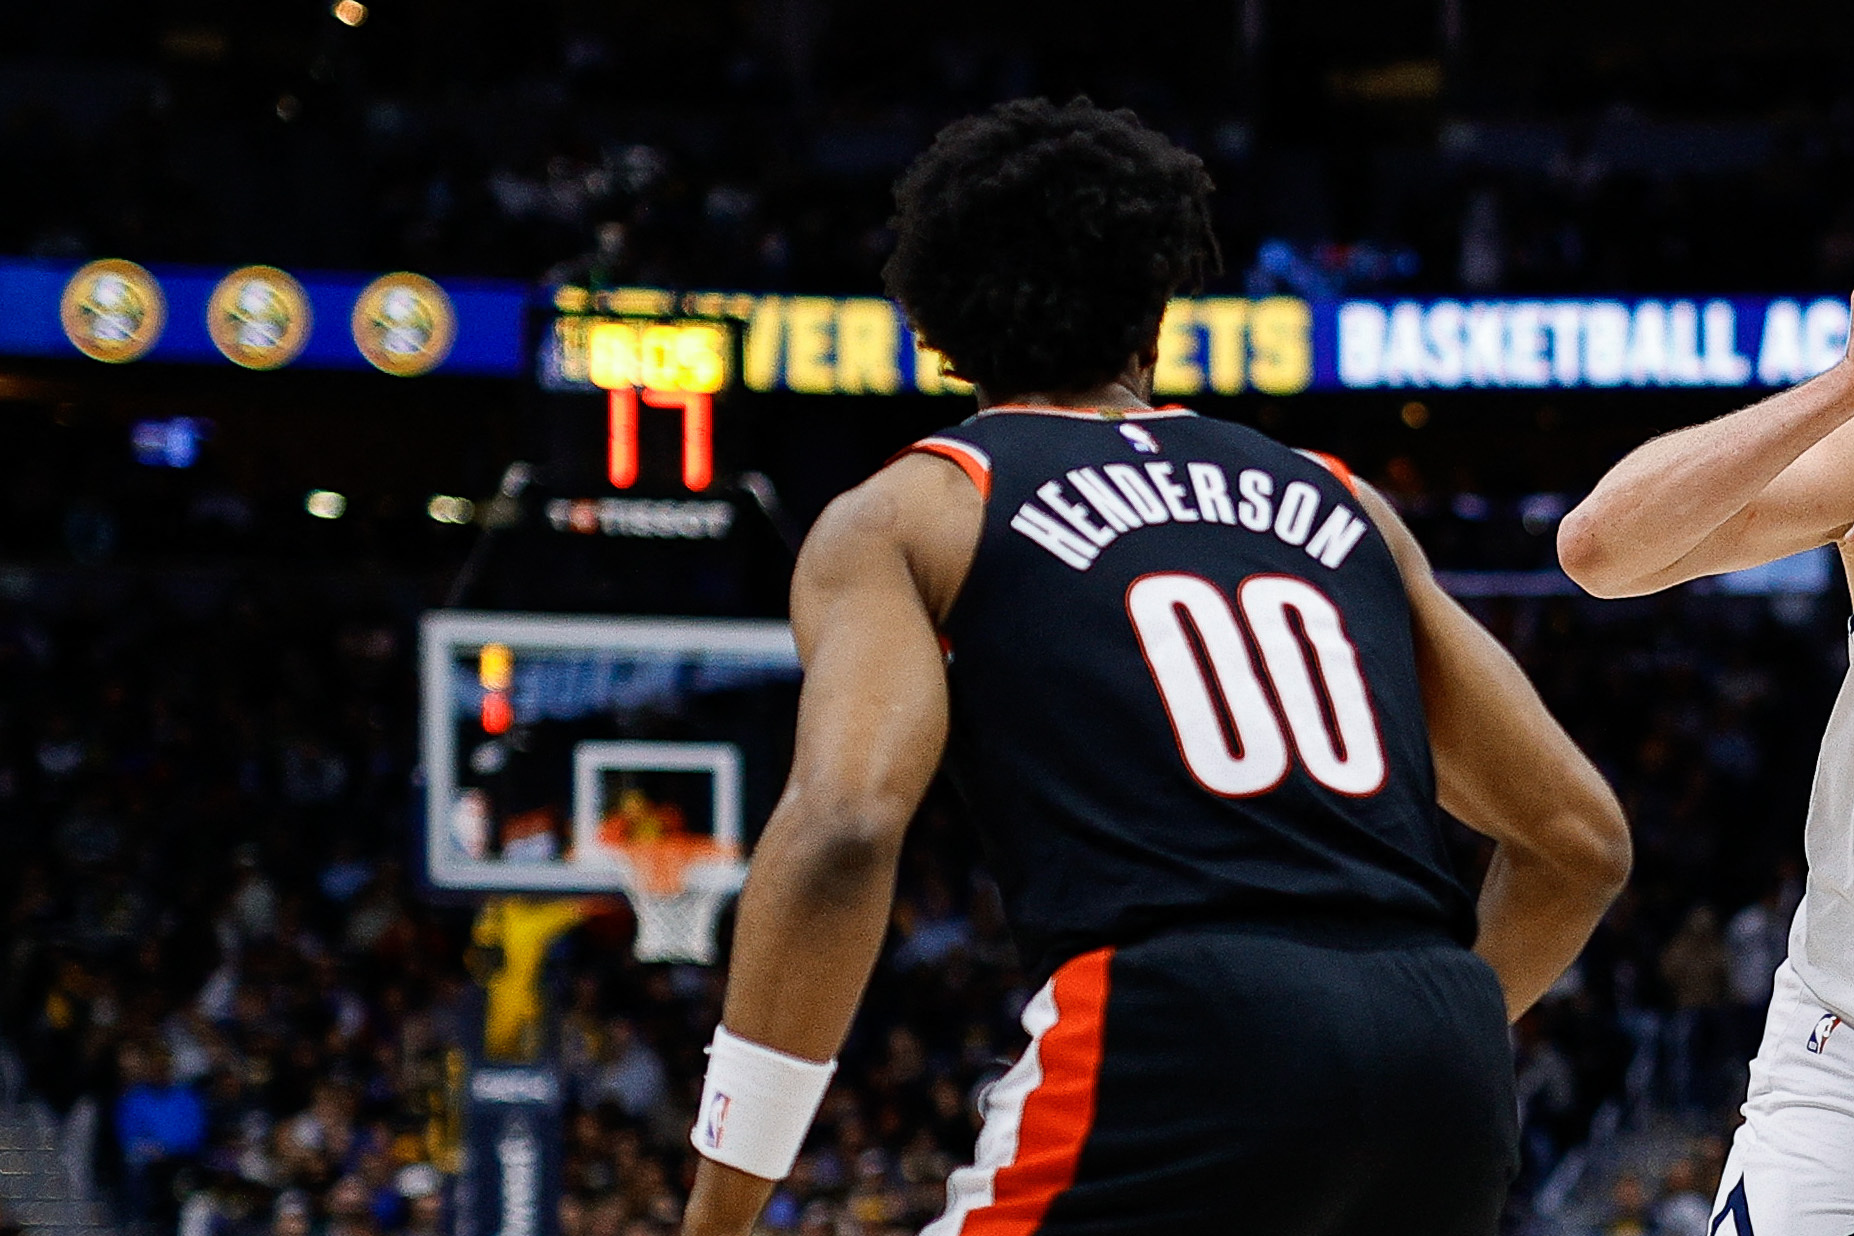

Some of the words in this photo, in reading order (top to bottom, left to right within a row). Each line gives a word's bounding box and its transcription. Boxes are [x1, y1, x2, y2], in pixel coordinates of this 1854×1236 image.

[1336, 299, 1752, 388] BASKETBALL
[1010, 461, 1368, 572] HENDERSON
[1125, 571, 1387, 799] 00
